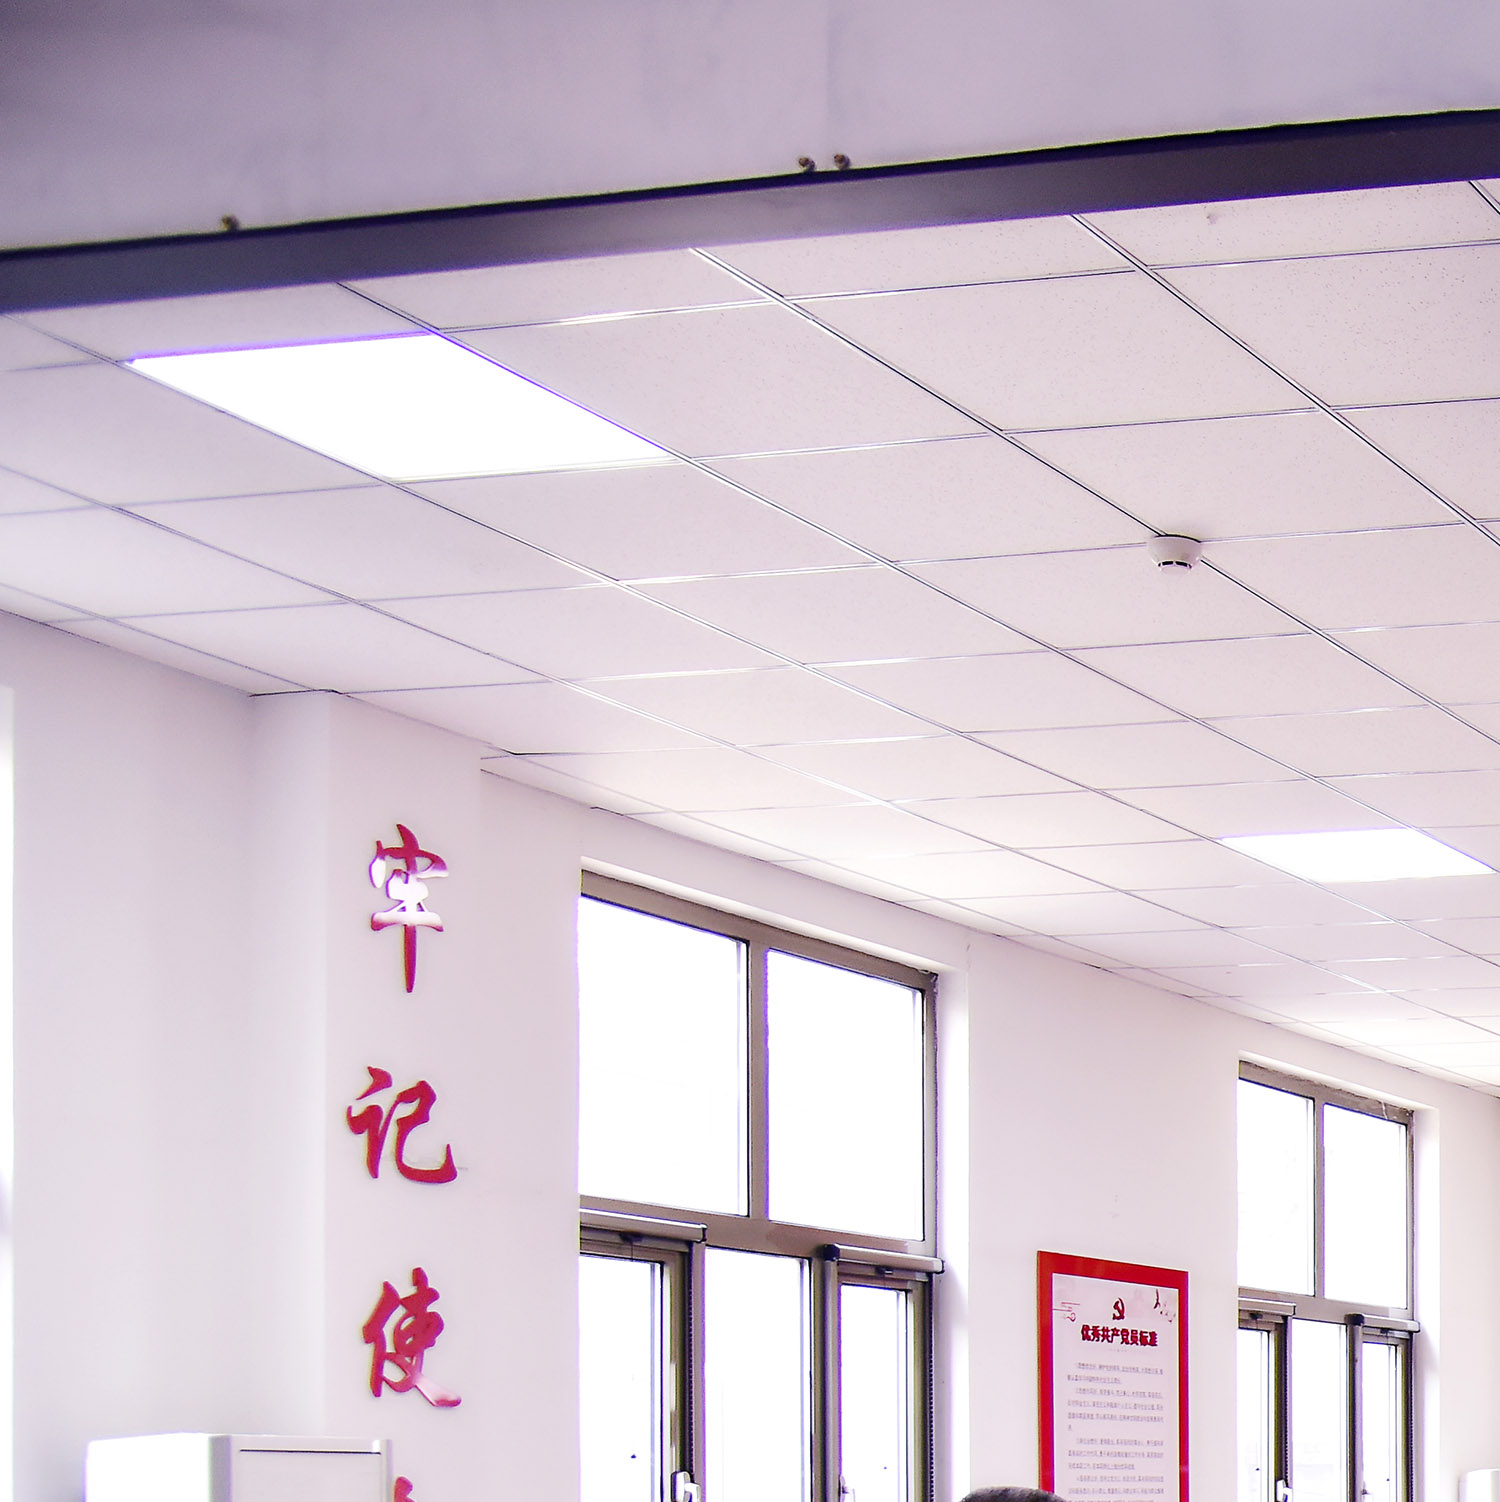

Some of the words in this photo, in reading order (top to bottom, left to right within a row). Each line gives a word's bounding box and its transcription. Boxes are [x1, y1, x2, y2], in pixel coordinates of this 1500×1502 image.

[1081, 1324, 1158, 1347] 优秀共产党员标准
